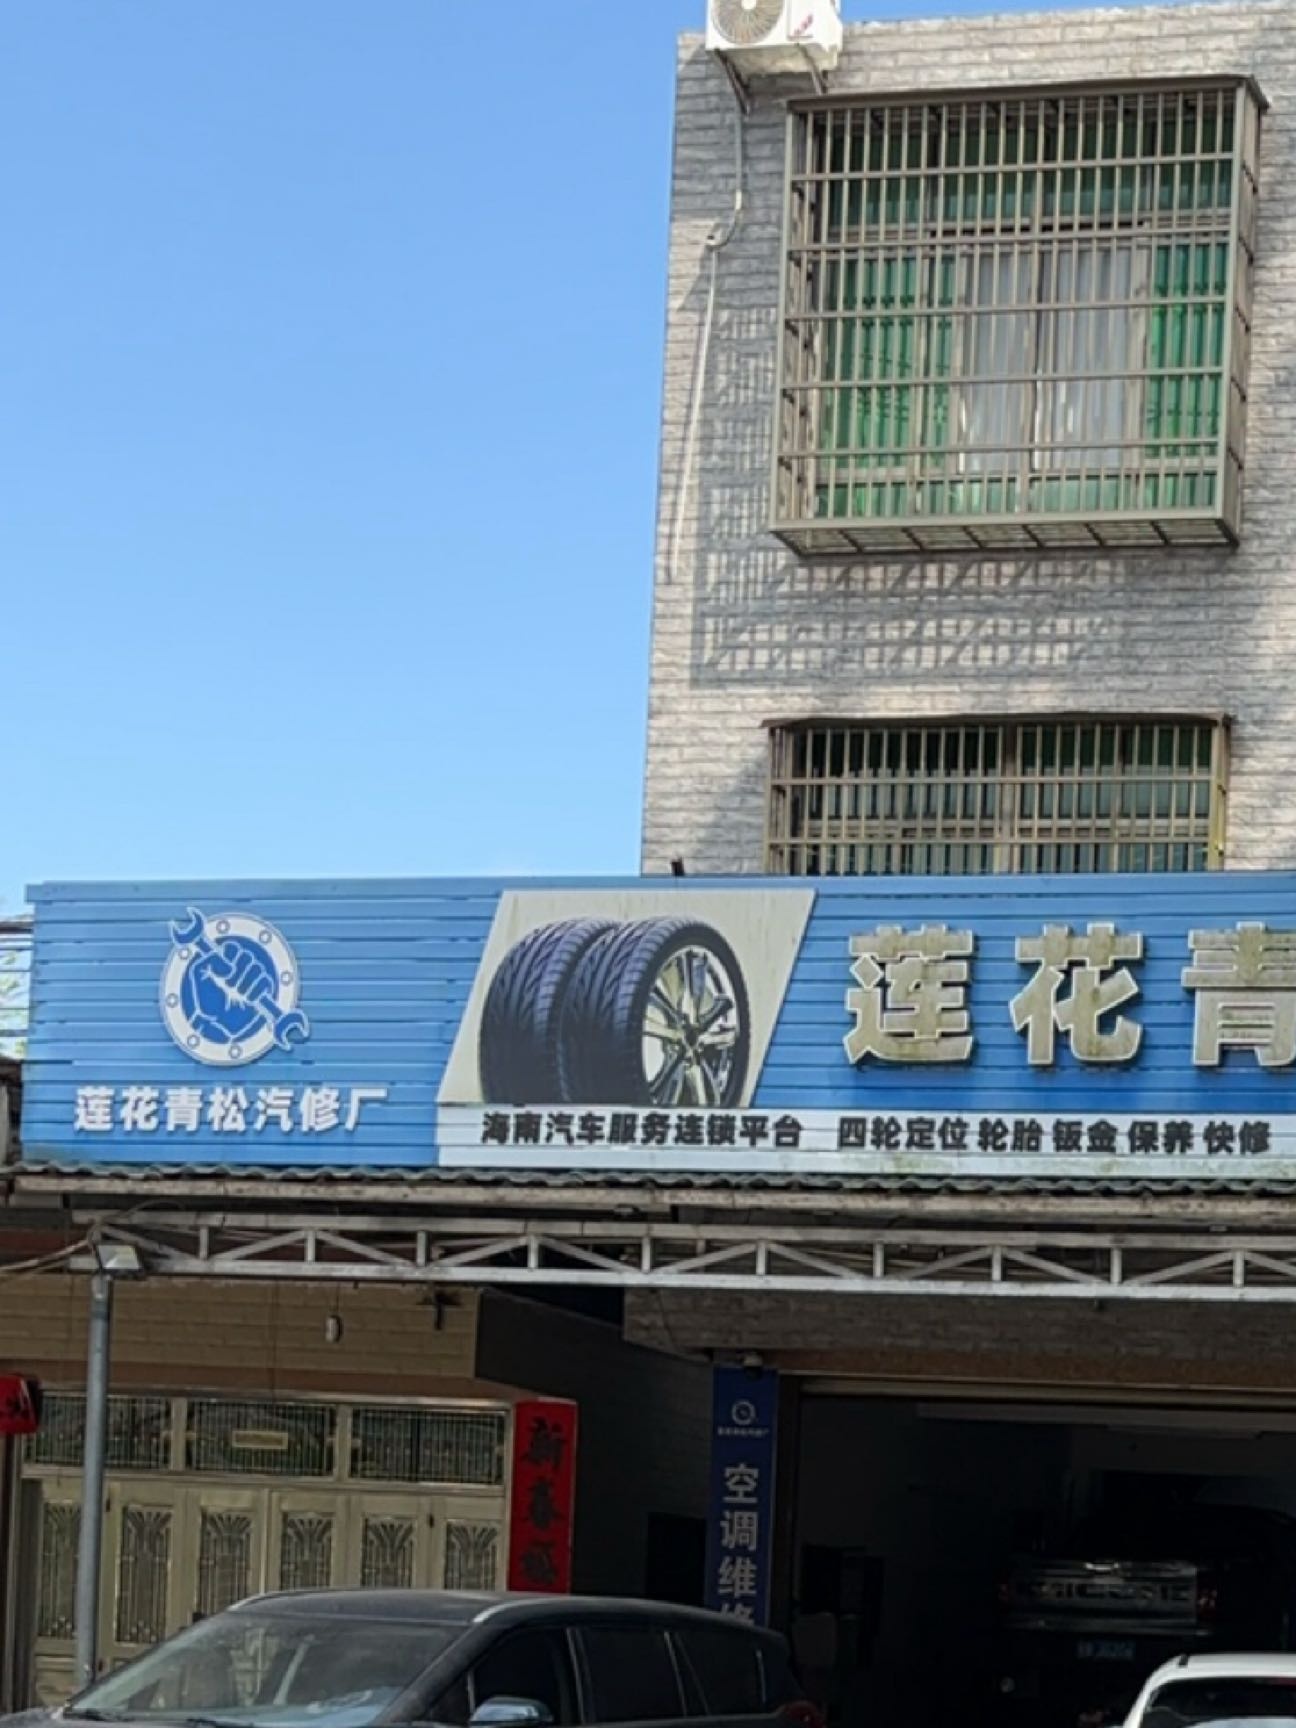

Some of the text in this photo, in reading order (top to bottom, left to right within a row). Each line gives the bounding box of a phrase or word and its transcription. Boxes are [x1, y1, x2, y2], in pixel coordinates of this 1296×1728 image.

[74, 1086, 388, 1132] 莲花青松汽修厂
[481, 1111, 803, 1147] 海南汽车服务连锁平台
[838, 1116, 1271, 1154] 四轮定位 轮胎 钣金 保养 快修
